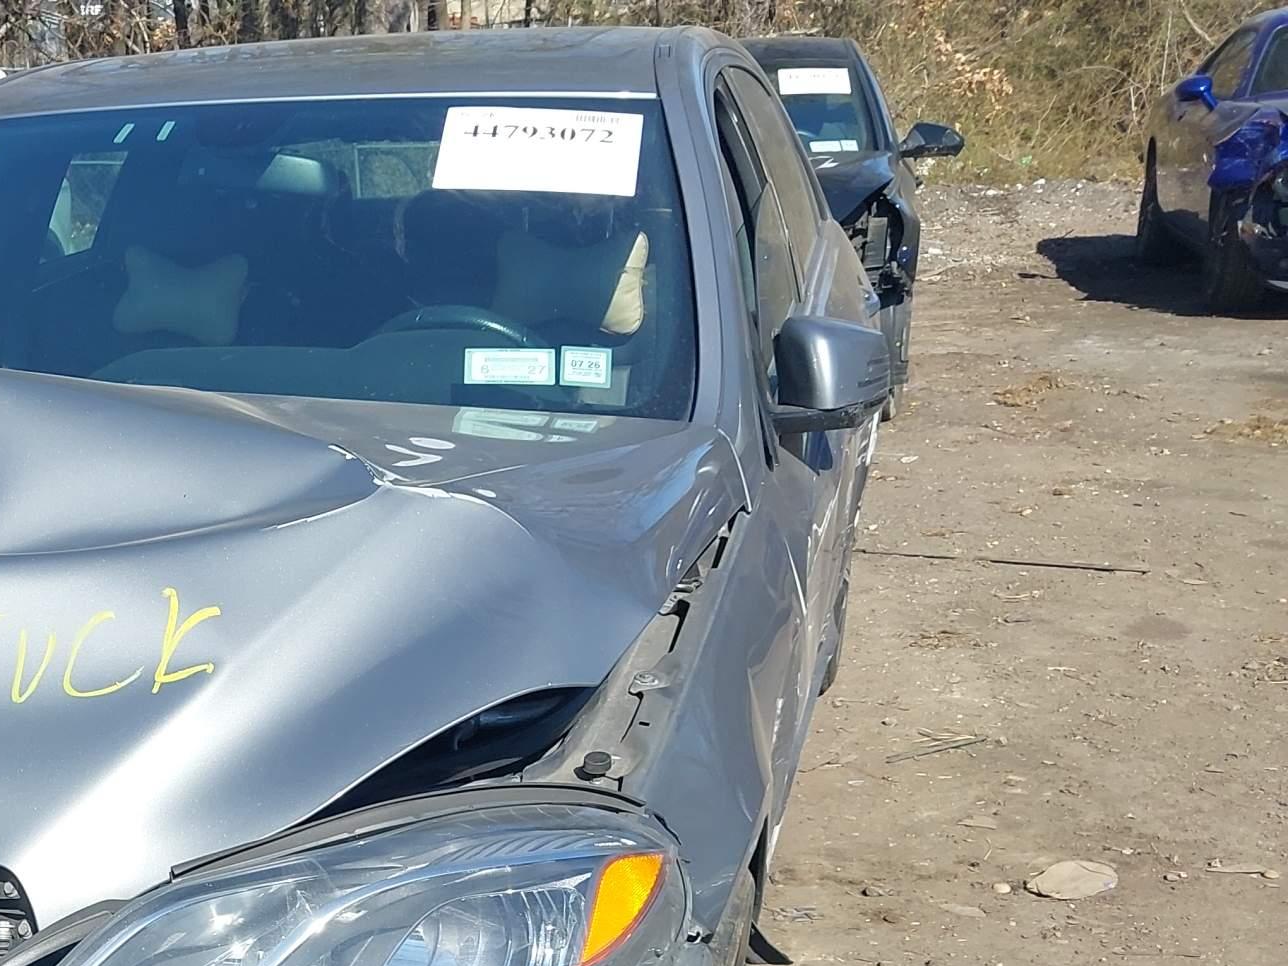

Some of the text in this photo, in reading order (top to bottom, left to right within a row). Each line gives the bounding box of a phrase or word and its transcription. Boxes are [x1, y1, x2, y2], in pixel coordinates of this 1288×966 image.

[463, 124, 614, 143] 44793072
[571, 359, 601, 369] 07 26
